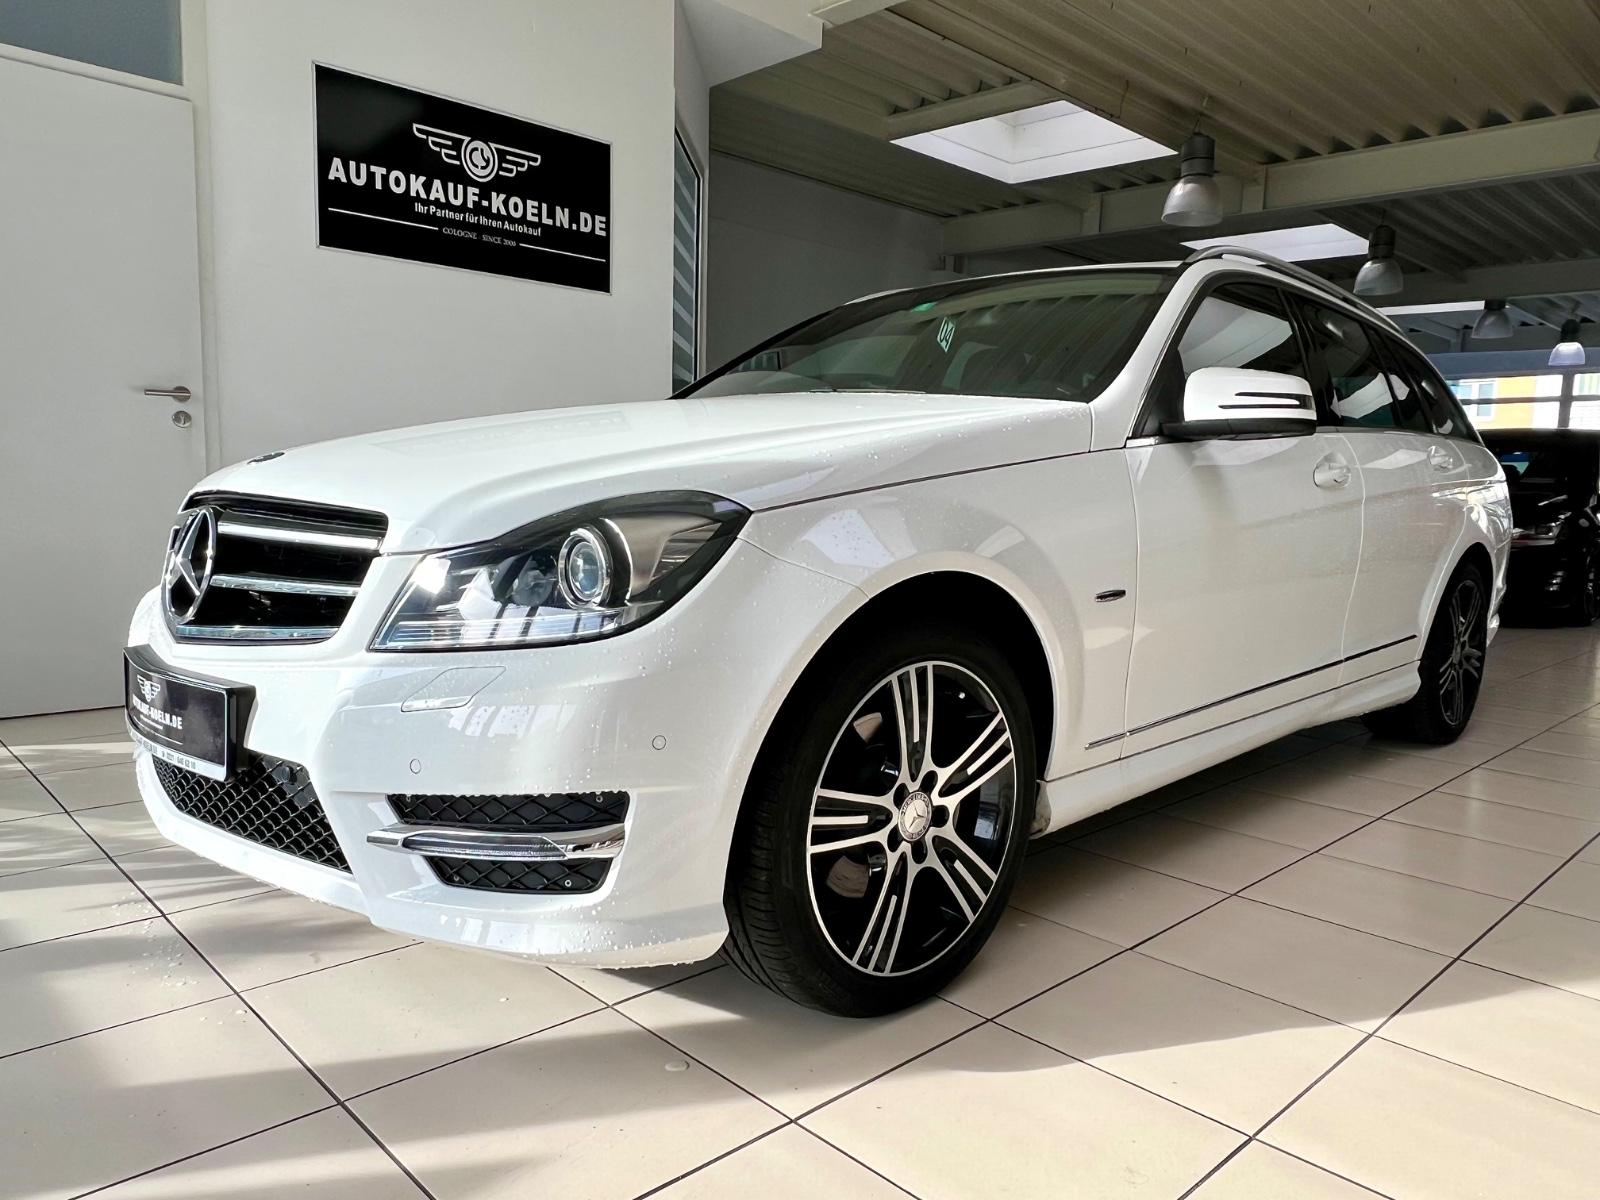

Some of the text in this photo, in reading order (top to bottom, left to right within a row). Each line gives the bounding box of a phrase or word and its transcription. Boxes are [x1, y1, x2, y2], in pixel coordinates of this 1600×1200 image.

[328, 157, 607, 236] AUTOKAUF-KOELN.DE
[415, 202, 542, 237] Ihr Partner für Ihren Autokauf
[442, 227, 478, 240] COLOGNE
[482, 234, 502, 245] SINCE
[132, 694, 183, 729] -KOELN.DE
